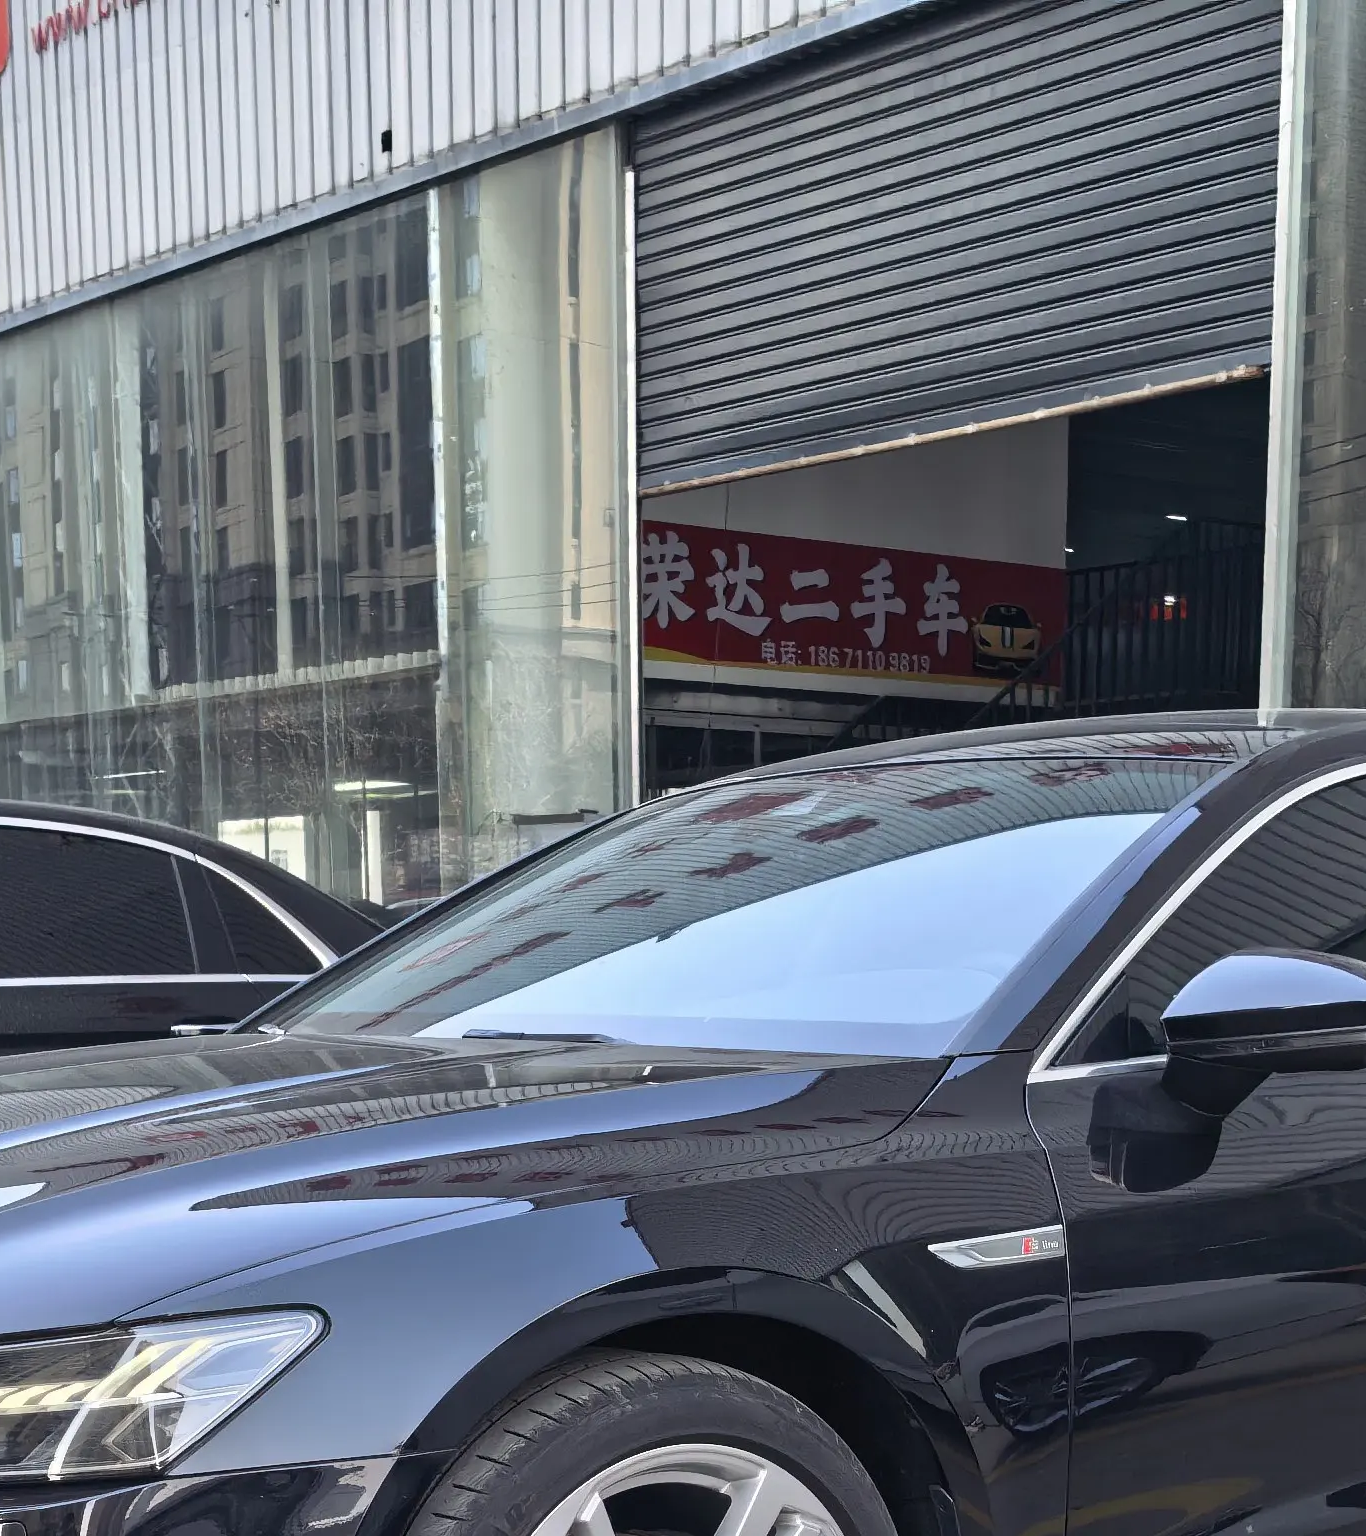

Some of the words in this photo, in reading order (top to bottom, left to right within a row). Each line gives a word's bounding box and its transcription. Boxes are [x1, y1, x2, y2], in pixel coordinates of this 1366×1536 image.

[642, 530, 969, 658] 荣达二手车
